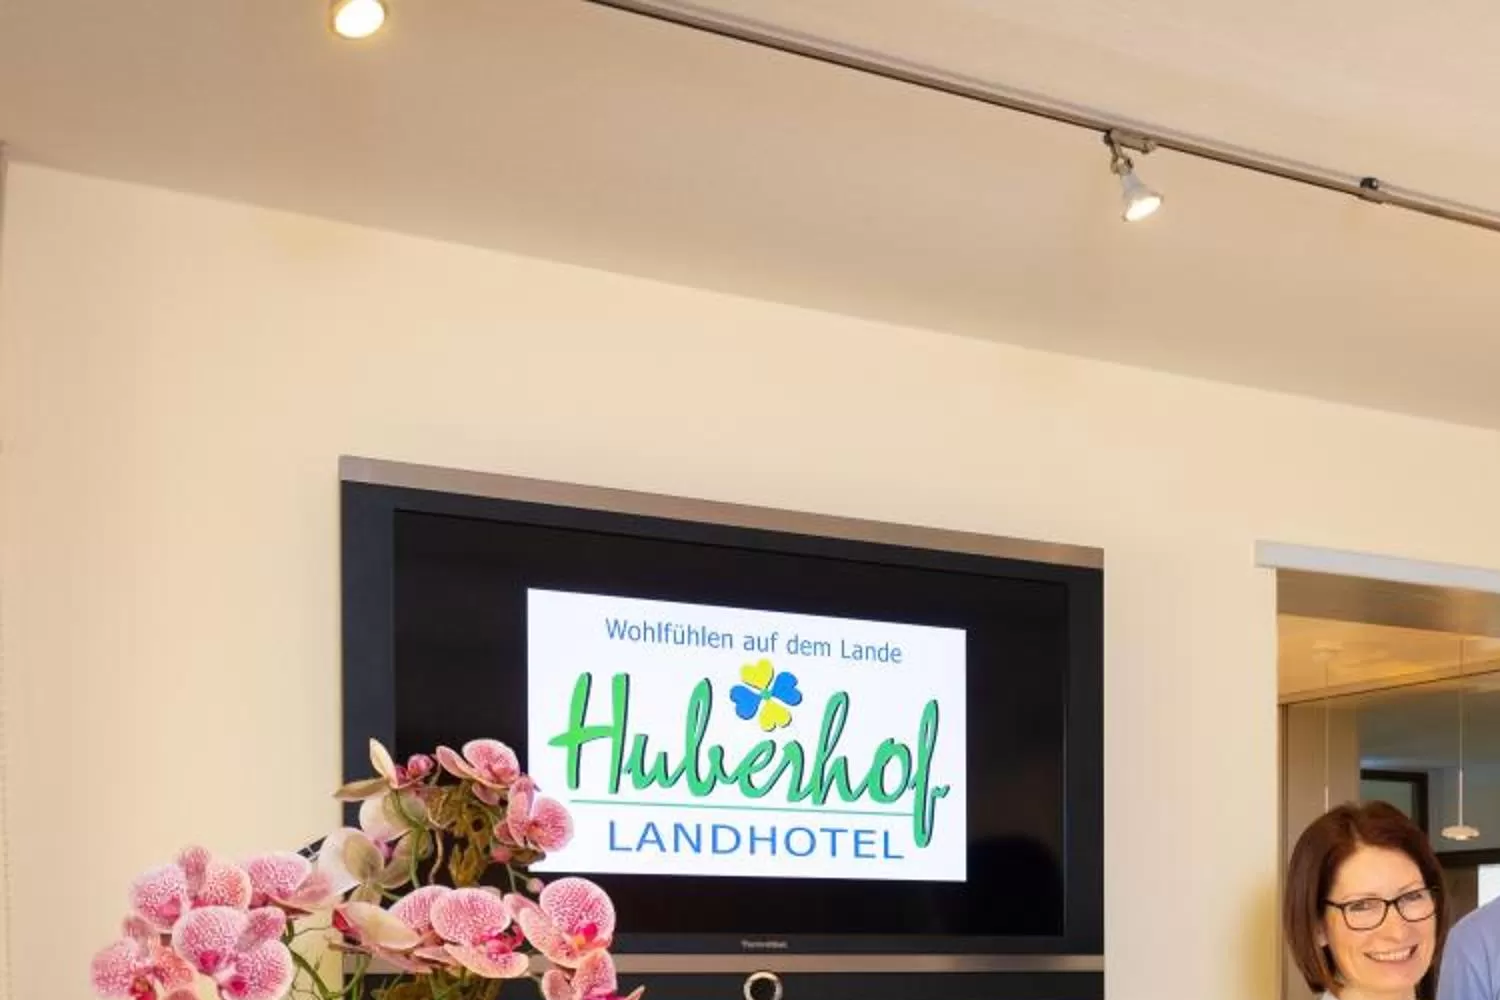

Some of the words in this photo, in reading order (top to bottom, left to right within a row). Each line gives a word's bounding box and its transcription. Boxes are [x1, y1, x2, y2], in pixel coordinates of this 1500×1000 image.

[605, 617, 734, 650] Wohlfühlen
[743, 631, 779, 653] auf
[786, 634, 831, 657] dem
[840, 639, 903, 663] Lande
[547, 671, 951, 848] Huberhof
[608, 819, 904, 860] LANDHOTEL
